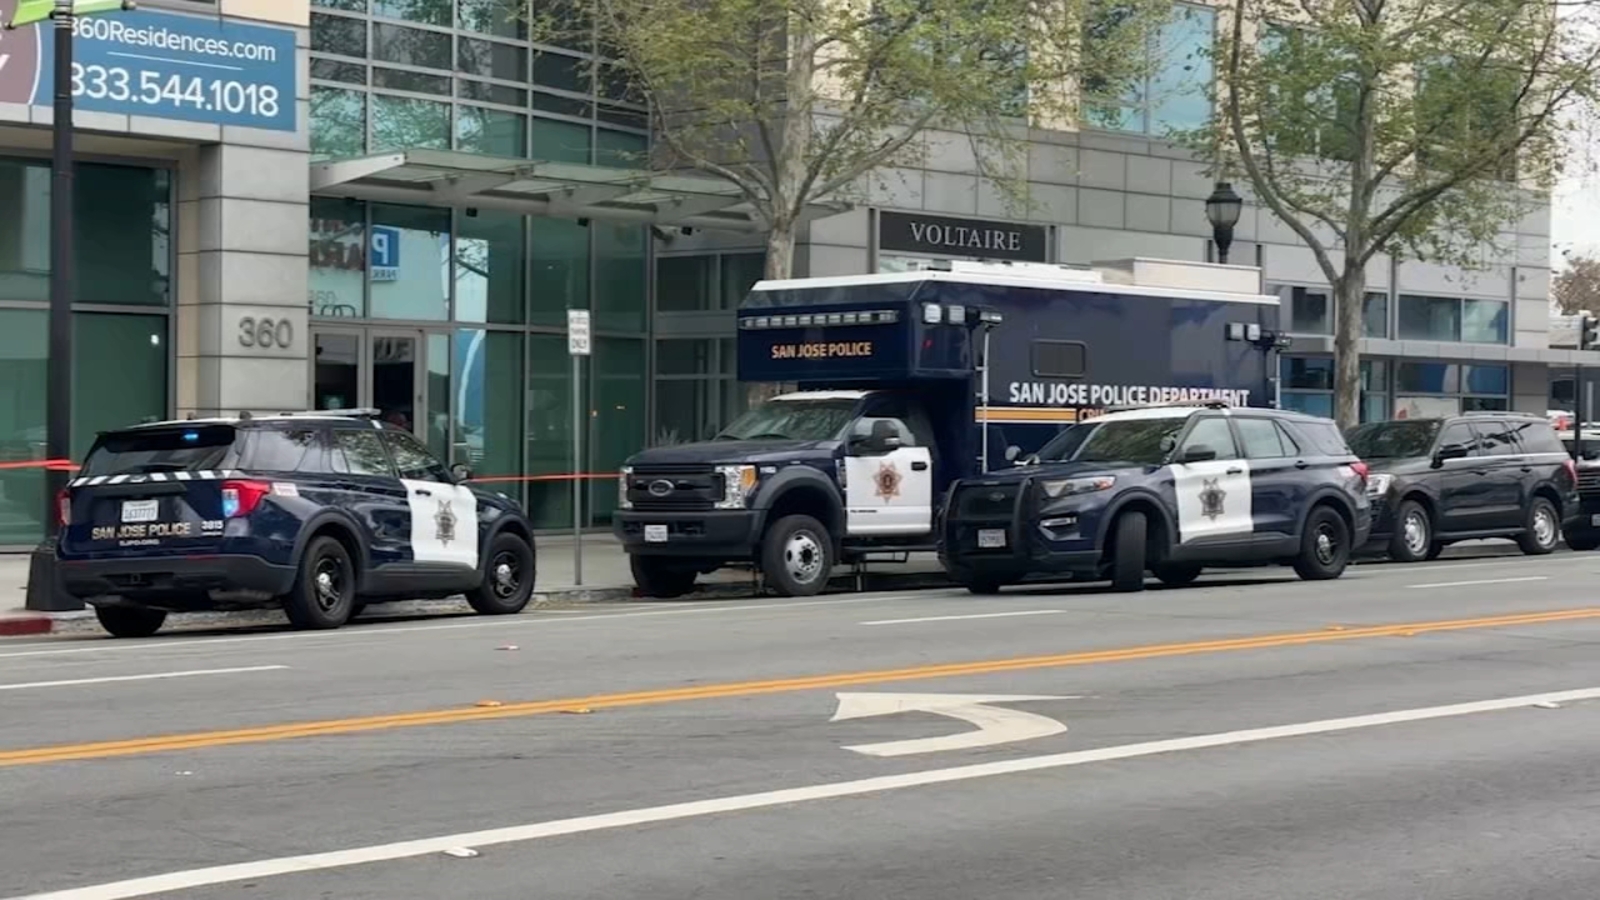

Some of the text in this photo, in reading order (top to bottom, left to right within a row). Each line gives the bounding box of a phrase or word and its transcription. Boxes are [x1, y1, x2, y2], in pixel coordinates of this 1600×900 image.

[910, 222, 1021, 251] VOLTAIRE
[238, 316, 294, 350] 360
[771, 341, 872, 359] SAN JOSE POLICE
[1009, 381, 1250, 407] SAN JOSE POLICE DEPARTMENT
[92, 521, 191, 540] SAN JOSE POLICE
